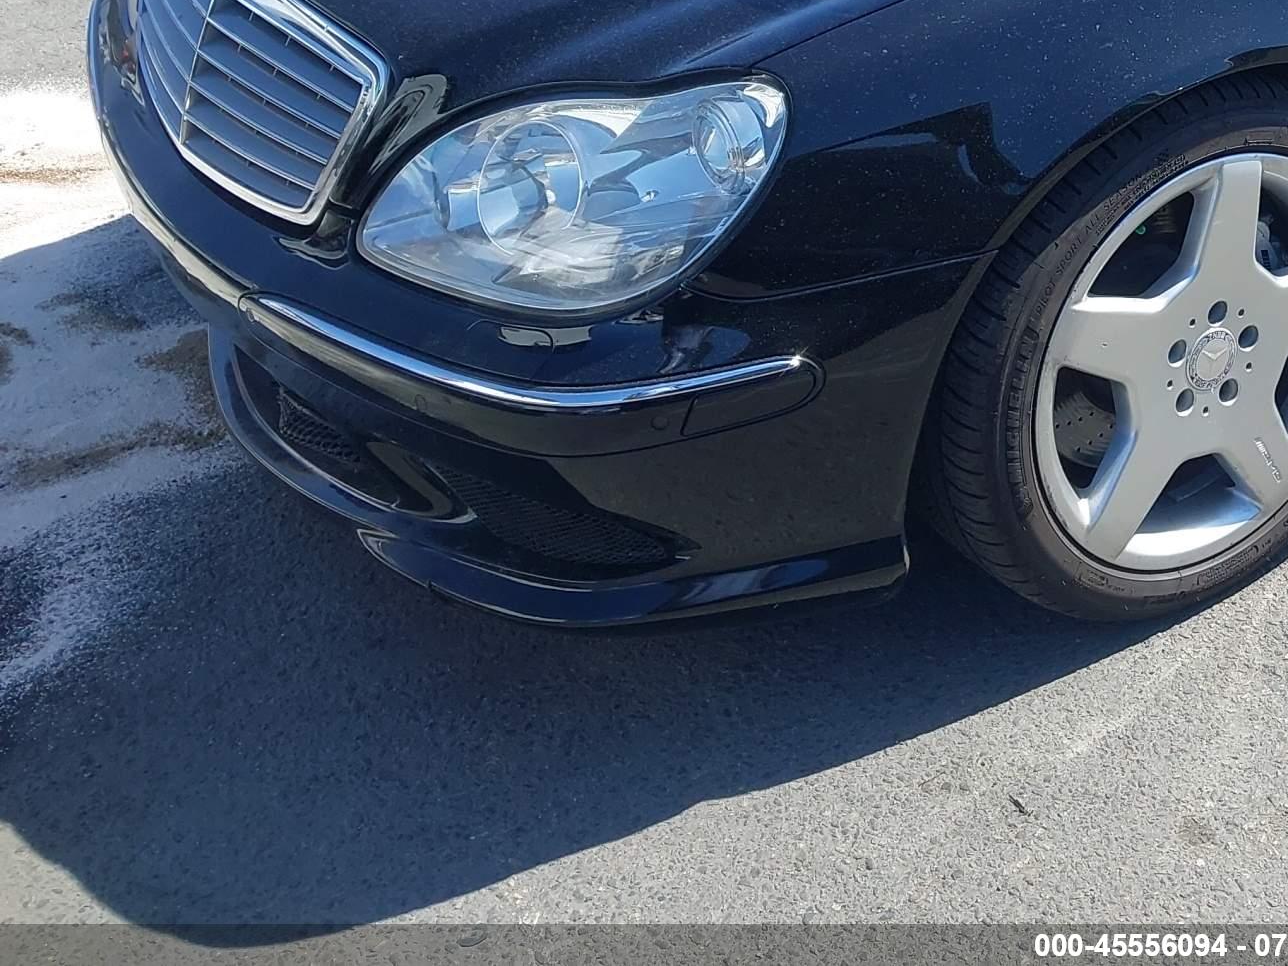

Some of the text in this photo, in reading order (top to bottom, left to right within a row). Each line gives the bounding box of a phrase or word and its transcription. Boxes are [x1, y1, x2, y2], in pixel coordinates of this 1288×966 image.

[1036, 279, 1057, 316] PILOT
[1055, 236, 1083, 276] SPORT
[1085, 213, 1101, 235] ALL
